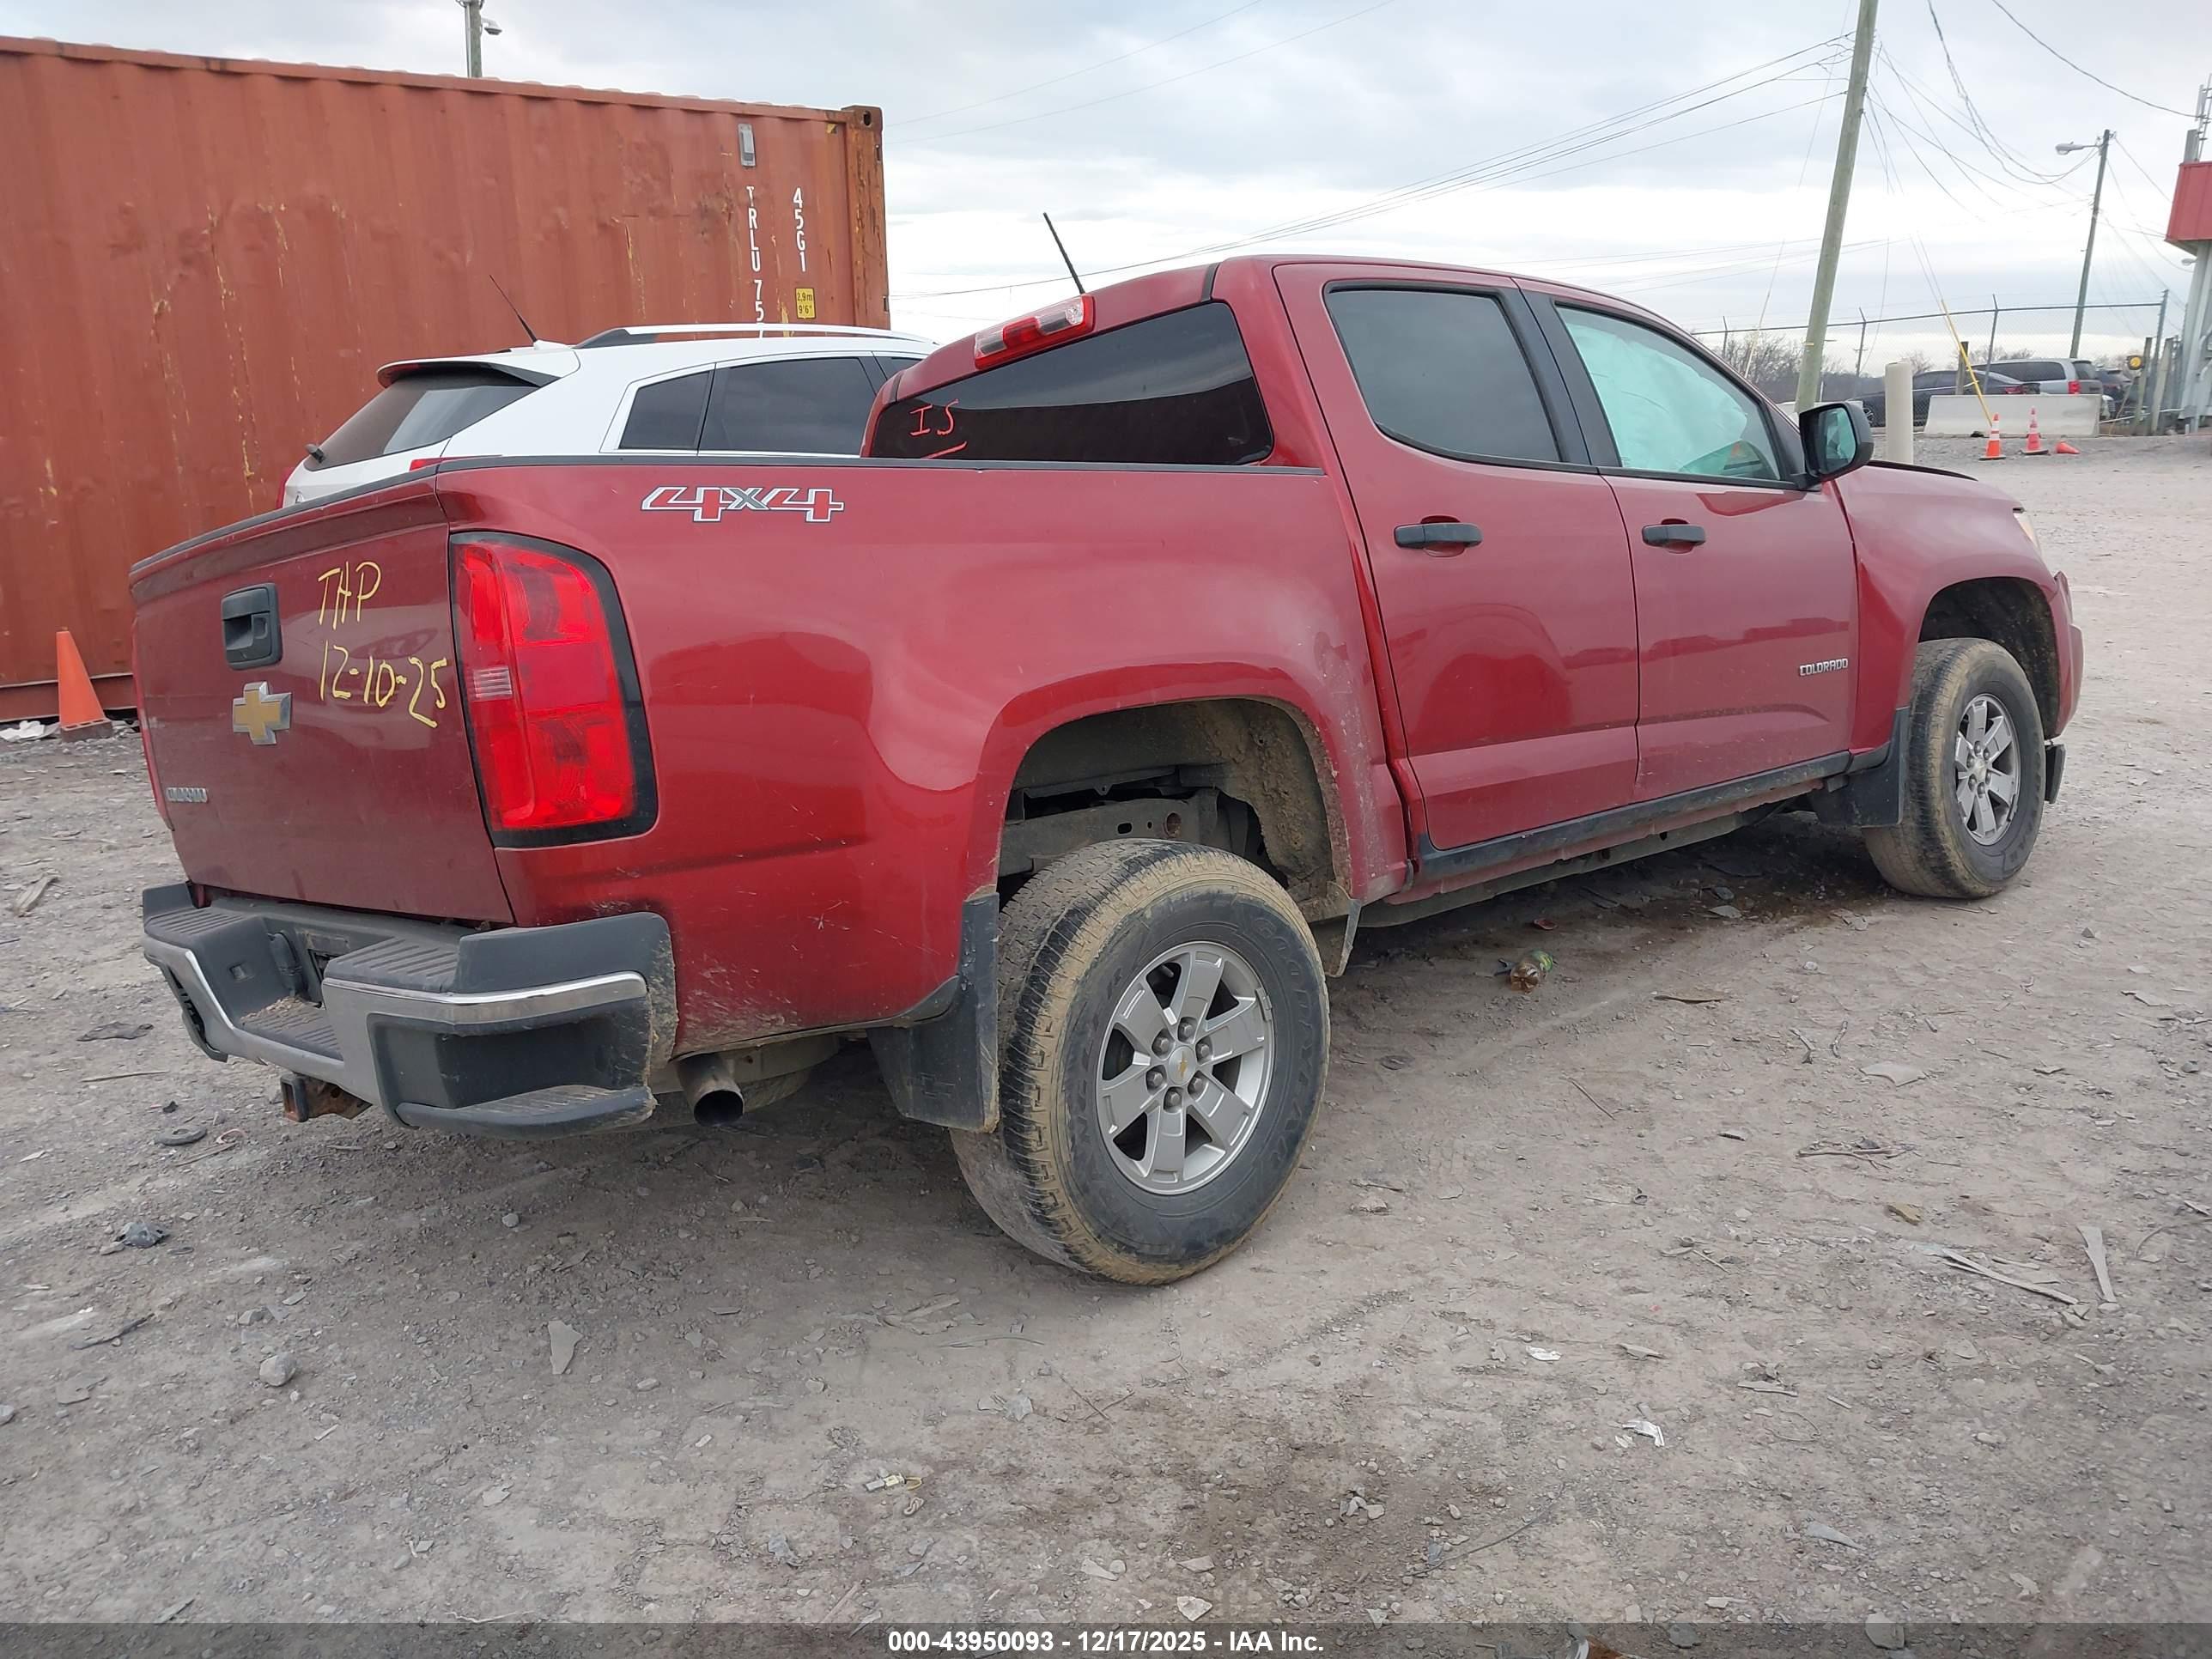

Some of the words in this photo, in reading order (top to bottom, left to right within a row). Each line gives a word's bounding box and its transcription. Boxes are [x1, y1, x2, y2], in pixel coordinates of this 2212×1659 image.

[746, 185, 761, 272] TRLU
[754, 279, 764, 338] 75
[793, 187, 806, 272] 45G1
[318, 561, 381, 630] THP
[319, 640, 447, 728] 12-10-25
[1799, 658, 1849, 677] COLORADO
